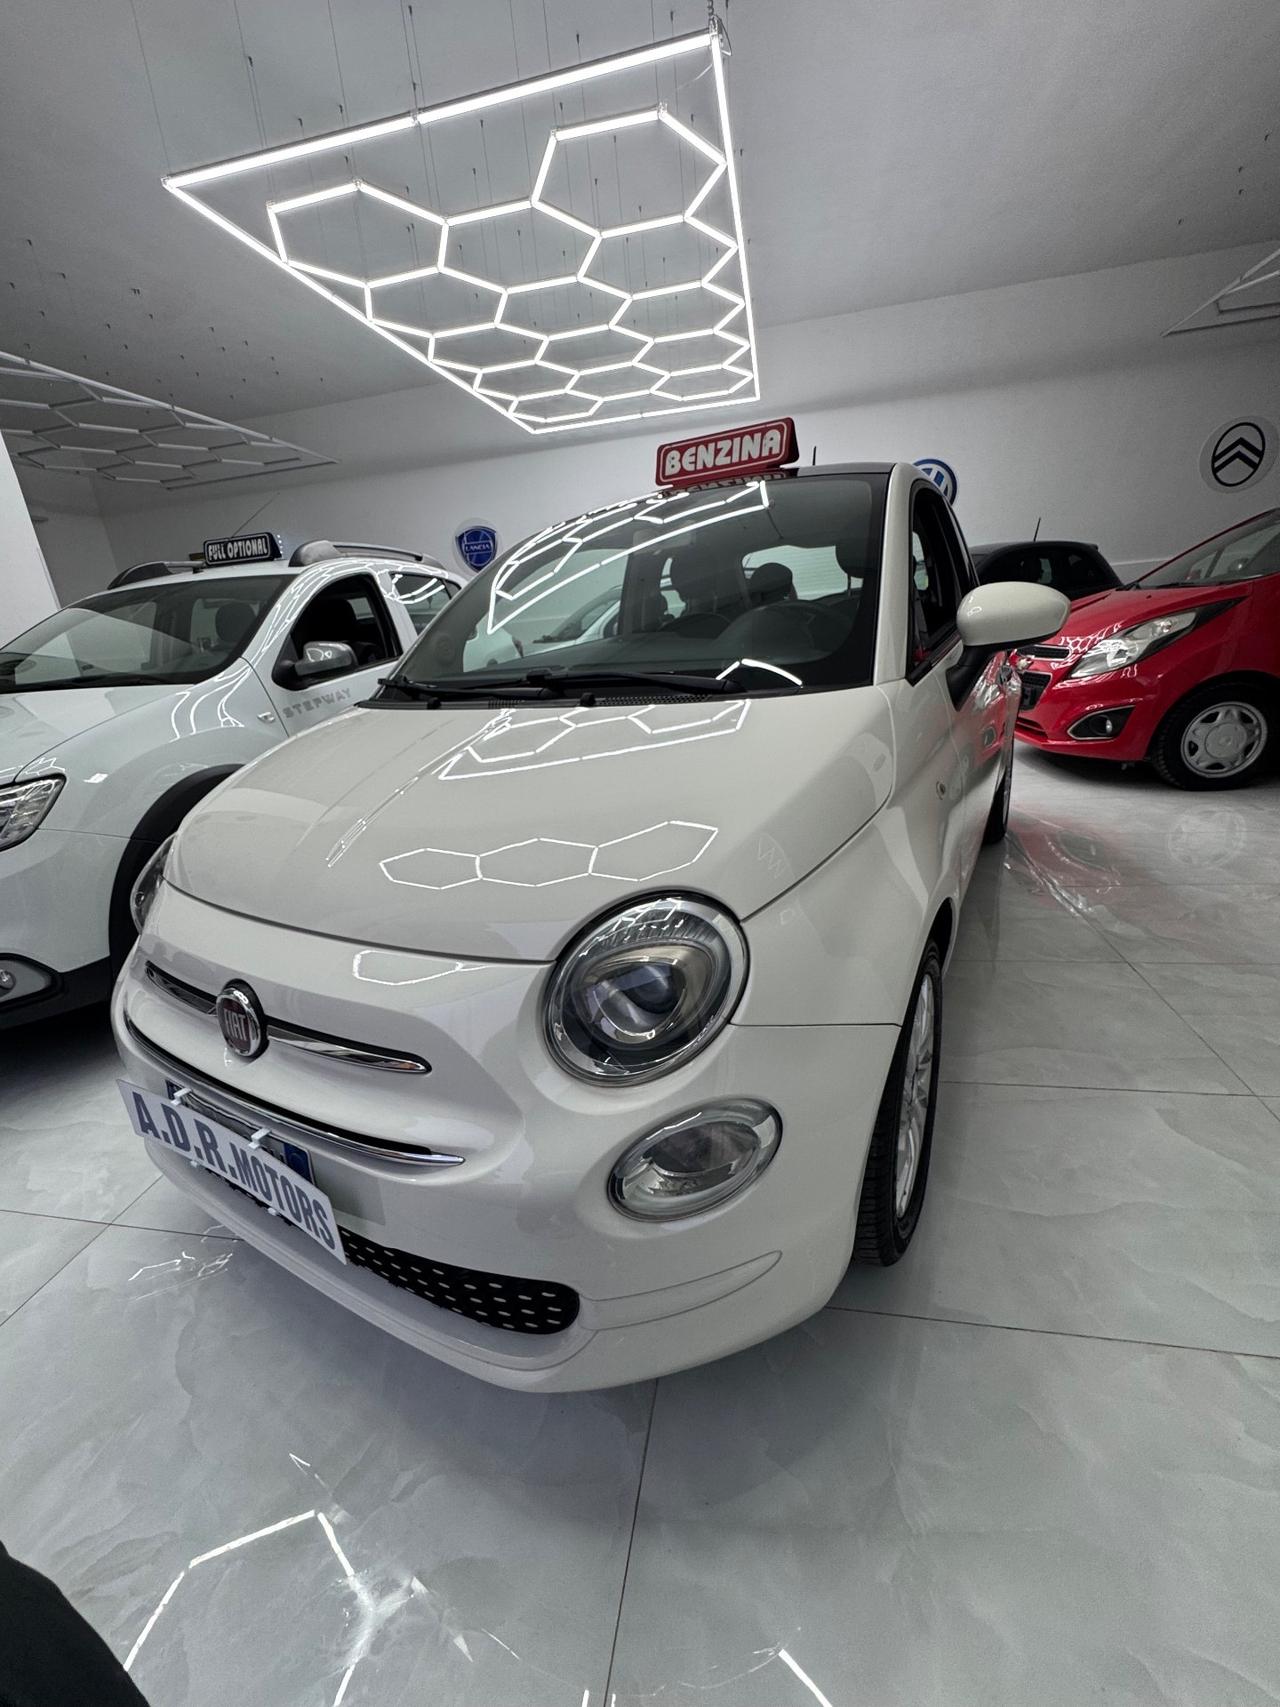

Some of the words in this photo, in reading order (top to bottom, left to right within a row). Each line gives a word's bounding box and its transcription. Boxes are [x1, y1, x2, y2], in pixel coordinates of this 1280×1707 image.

[665, 429, 781, 476] BENZINA
[208, 543, 226, 560] FULL
[227, 538, 268, 559] OPTIONAL
[283, 688, 351, 718] STEPWAY
[223, 1007, 247, 1041] FIAT
